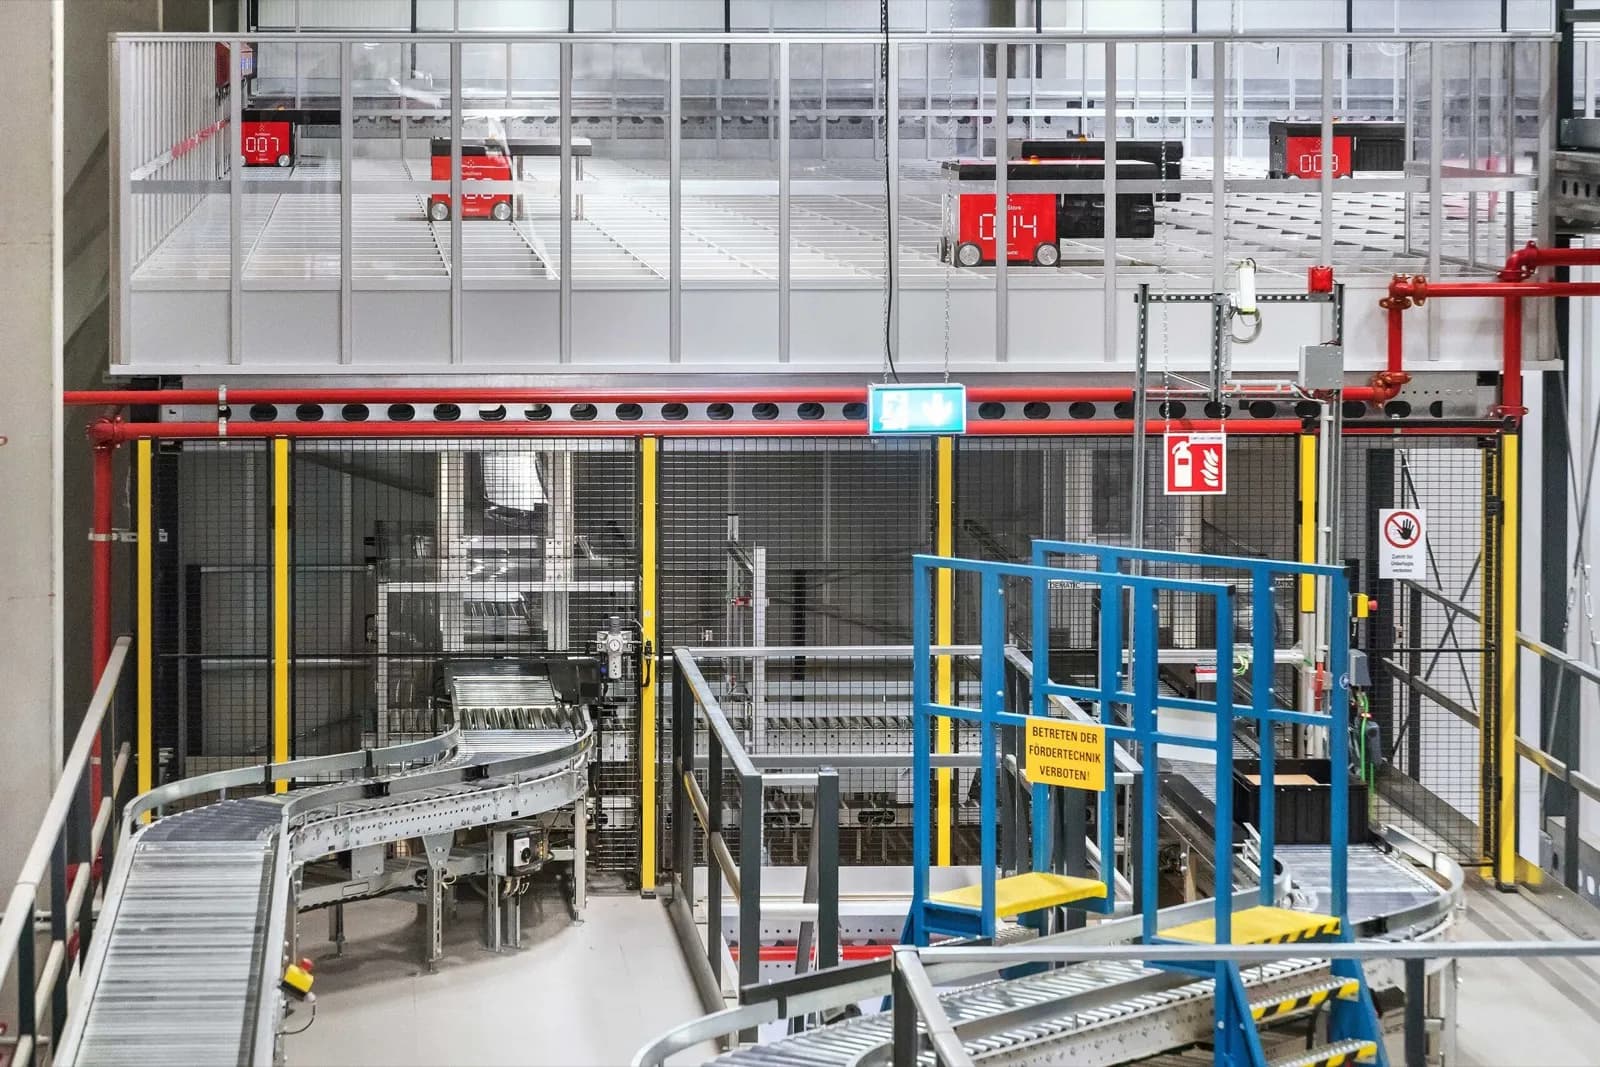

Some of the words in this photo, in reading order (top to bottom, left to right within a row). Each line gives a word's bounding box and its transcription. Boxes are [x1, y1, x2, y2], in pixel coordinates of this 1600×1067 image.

[246, 136, 279, 153] 007
[979, 213, 1037, 240] 014
[1032, 726, 1078, 742] BETRETEN
[1080, 732, 1098, 744] DER
[1029, 743, 1101, 764] FÖRDERTECHNIK
[1039, 765, 1090, 782] VERBOTEN!
